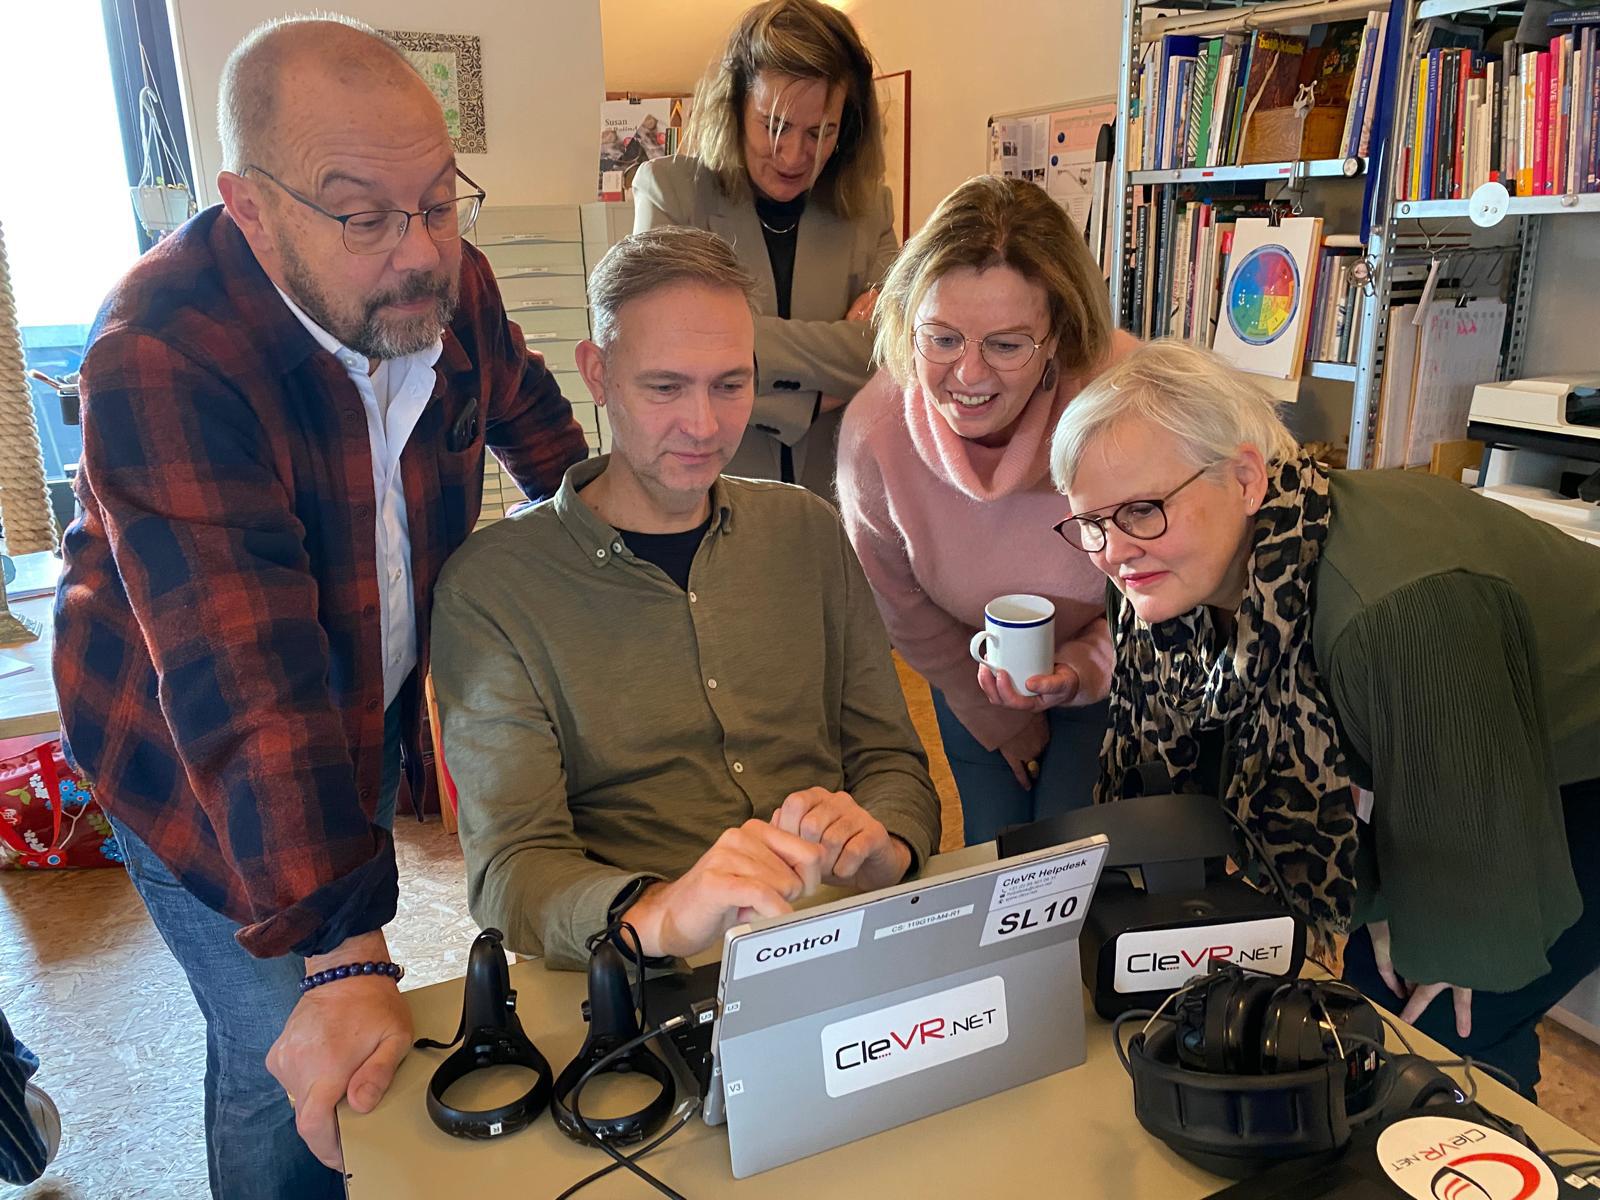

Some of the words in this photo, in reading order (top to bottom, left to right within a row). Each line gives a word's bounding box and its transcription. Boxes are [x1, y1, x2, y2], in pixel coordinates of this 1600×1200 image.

[1003, 872, 1037, 887] CleVR
[1038, 859, 1087, 878] Helpdesk
[756, 928, 841, 962] Control
[729, 1083, 741, 1093] V3
